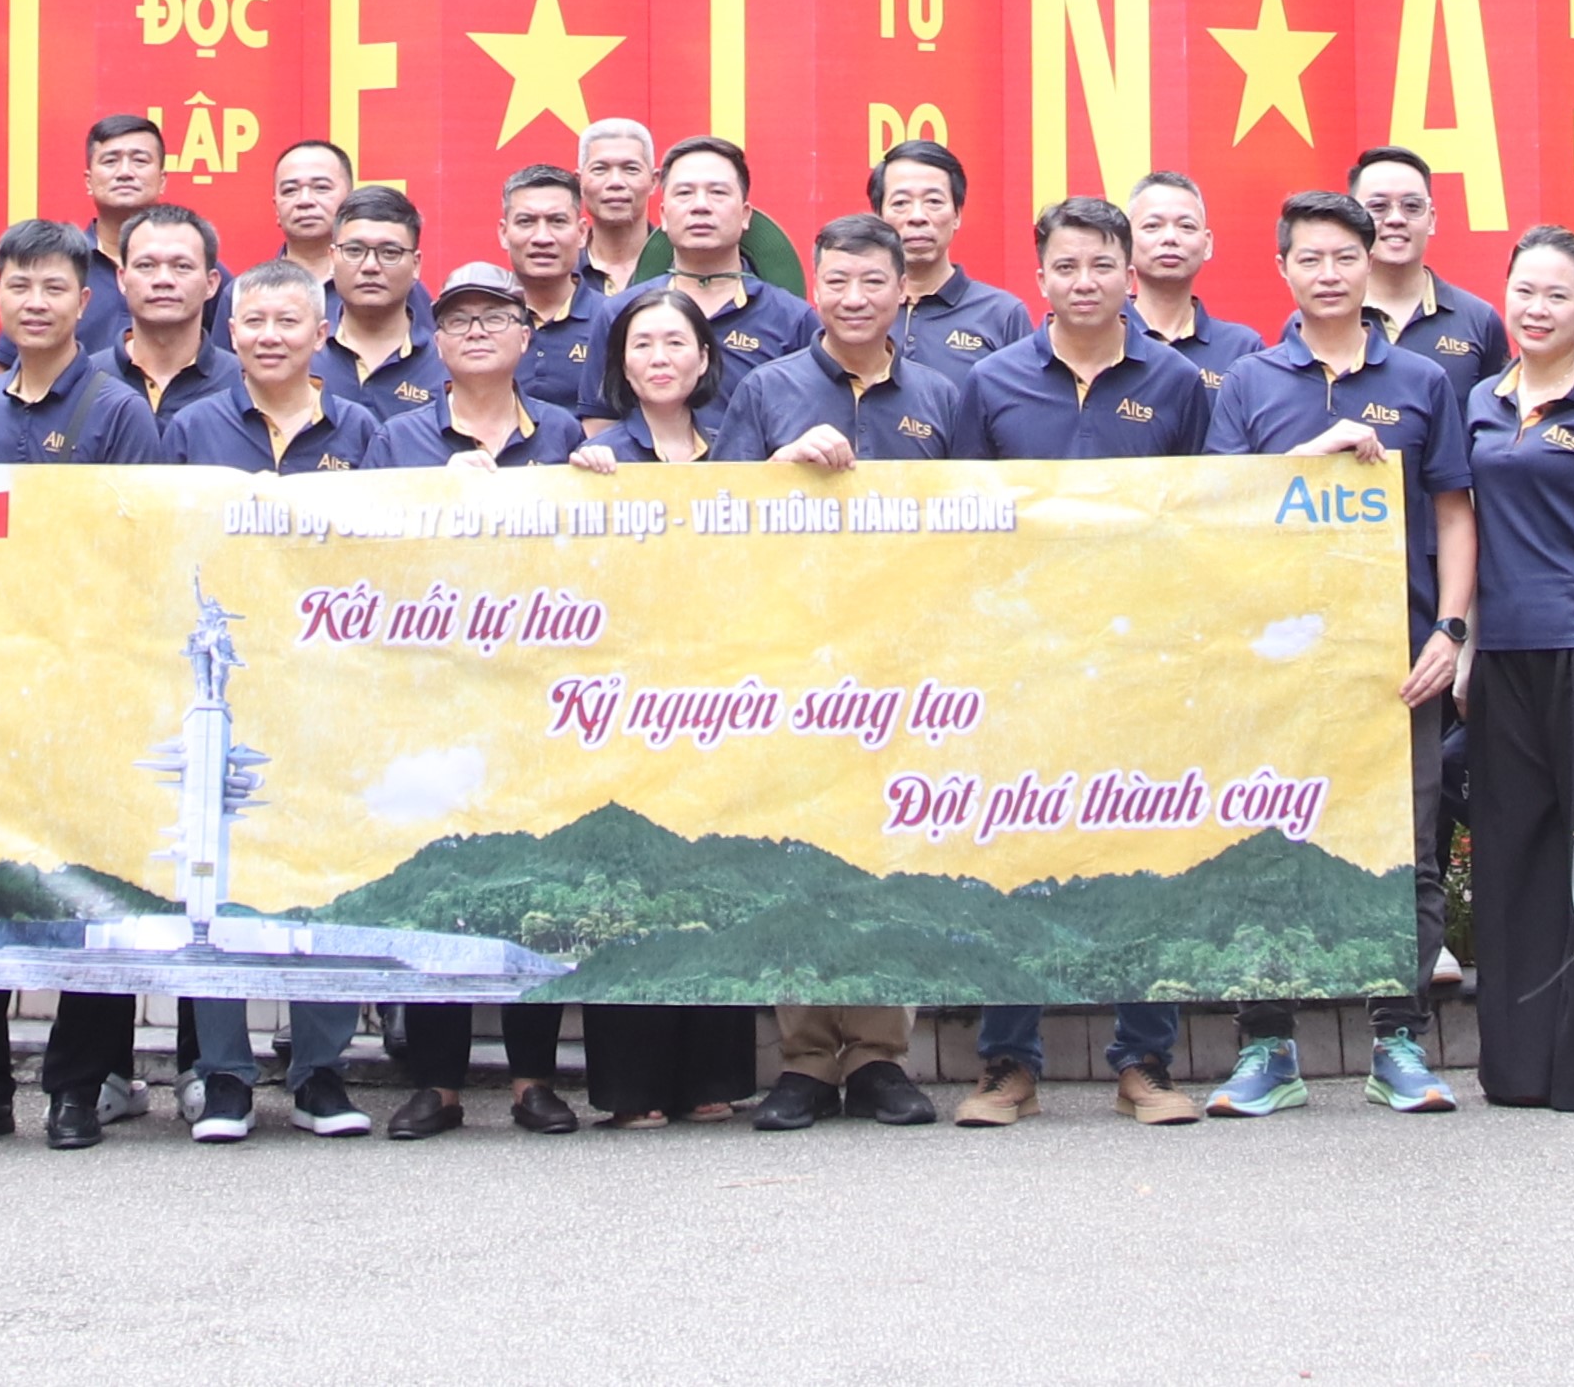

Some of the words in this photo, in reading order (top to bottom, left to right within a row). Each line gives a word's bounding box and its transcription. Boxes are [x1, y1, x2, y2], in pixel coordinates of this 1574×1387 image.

[148, 91, 260, 184] LẬP
[564, 500, 605, 534] TIN
[613, 499, 667, 542] HỌC
[691, 489, 749, 533] VIỄN
[756, 490, 842, 533] THÔNG
[848, 490, 919, 532] HÀNG
[926, 491, 1015, 531] KHÔNG
[1274, 476, 1388, 524] Aits
[301, 584, 379, 642] Kết
[388, 584, 458, 641] nối
[468, 596, 517, 652] tự
[521, 592, 602, 641] hào
[552, 677, 621, 744] Kỷ
[628, 680, 778, 745] nguyên
[794, 680, 899, 744] sáng
[911, 684, 980, 741] tạo
[889, 775, 976, 837] Đột
[980, 775, 1074, 839] phá
[1081, 771, 1204, 824] thành
[1222, 770, 1325, 834] công
